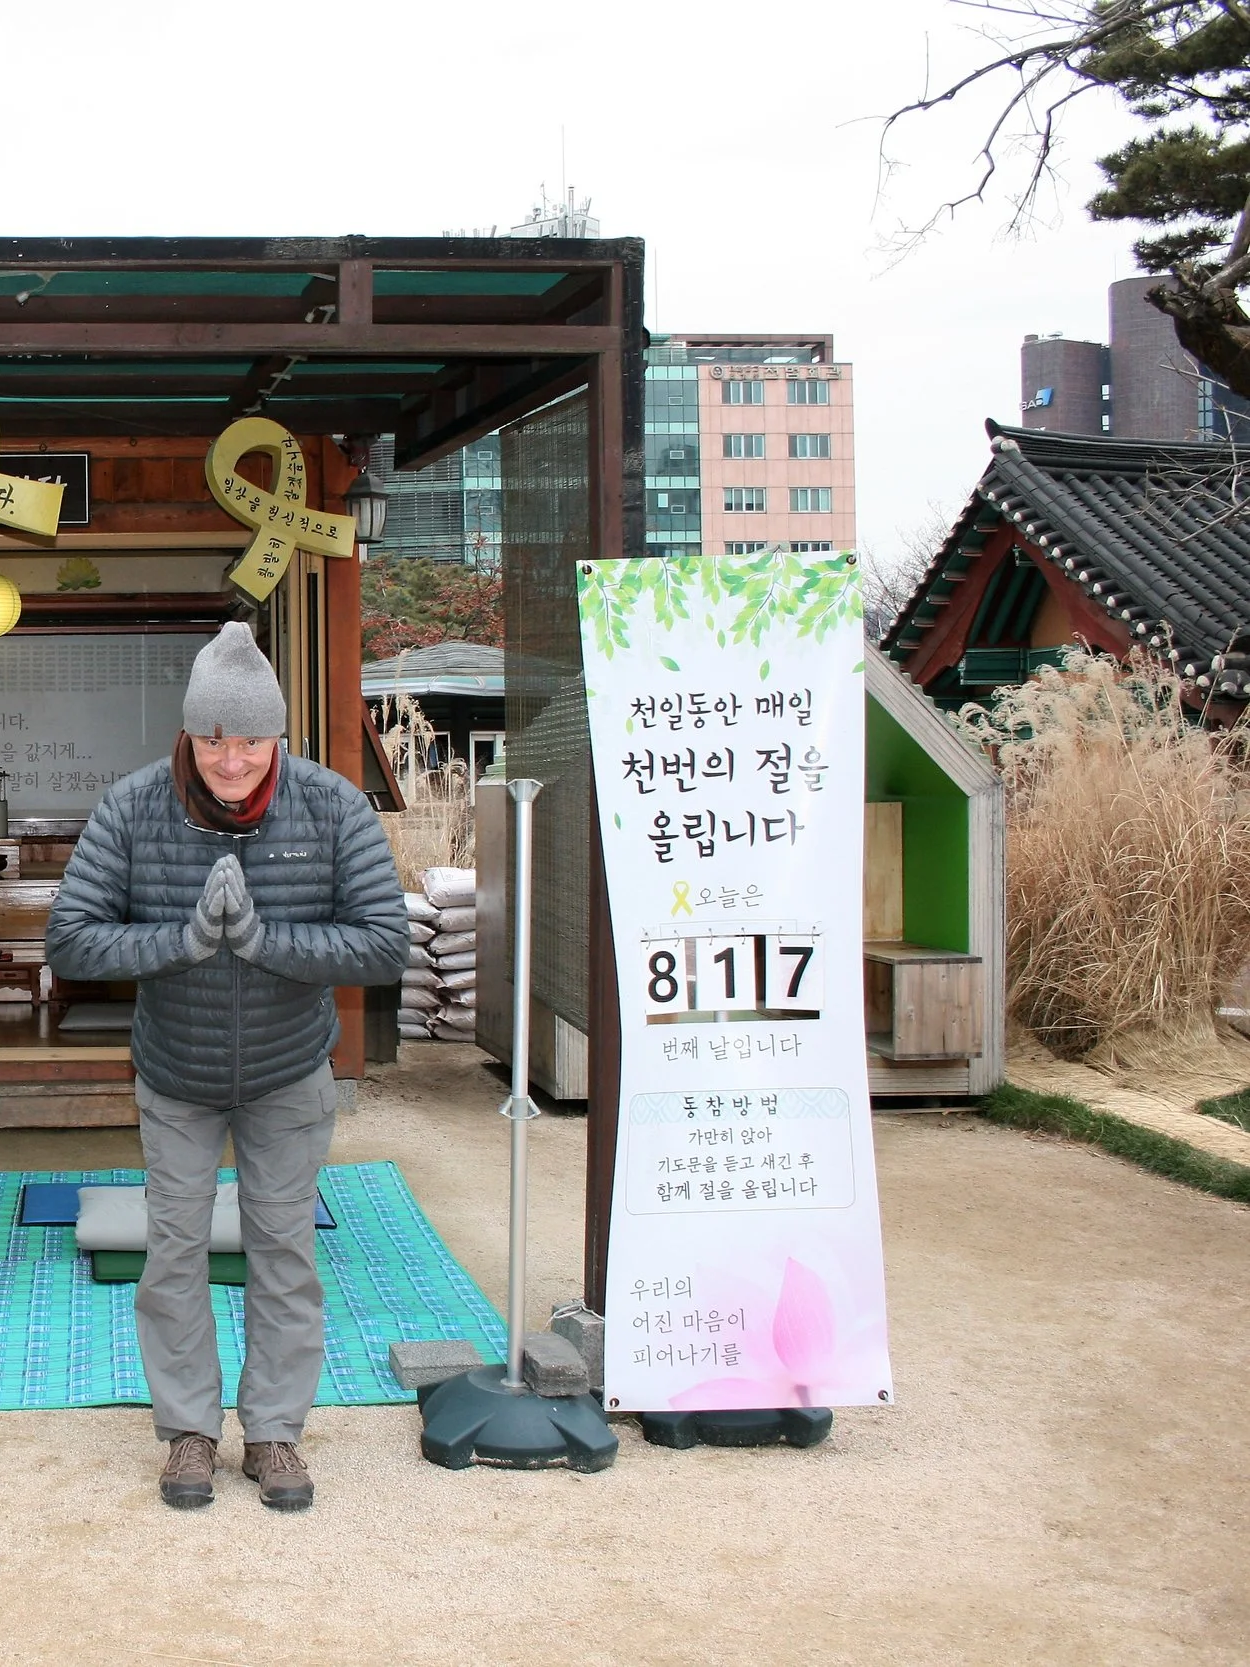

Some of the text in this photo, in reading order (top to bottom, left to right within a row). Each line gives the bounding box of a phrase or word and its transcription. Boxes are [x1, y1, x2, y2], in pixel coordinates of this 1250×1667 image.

[224, 478, 338, 539] 일상을 헌신적으로
[630, 688, 812, 731] 천일동안 매일
[50, 770, 132, 791] 살겠습니
[621, 742, 829, 794] 천번의 절을
[647, 809, 805, 863] 올립니다
[695, 885, 764, 909] 오늘은
[662, 1034, 802, 1062] 번째 날입니다
[688, 1126, 772, 1146] 가만히 앉아
[658, 1152, 815, 1174] 기도문을 듣고 새긴 후
[656, 1178, 818, 1202] 함께 절을 올립니다
[630, 1276, 692, 1301] 우리의
[633, 1308, 746, 1334] 어진 마음이
[633, 1342, 742, 1367] 피어나기를
